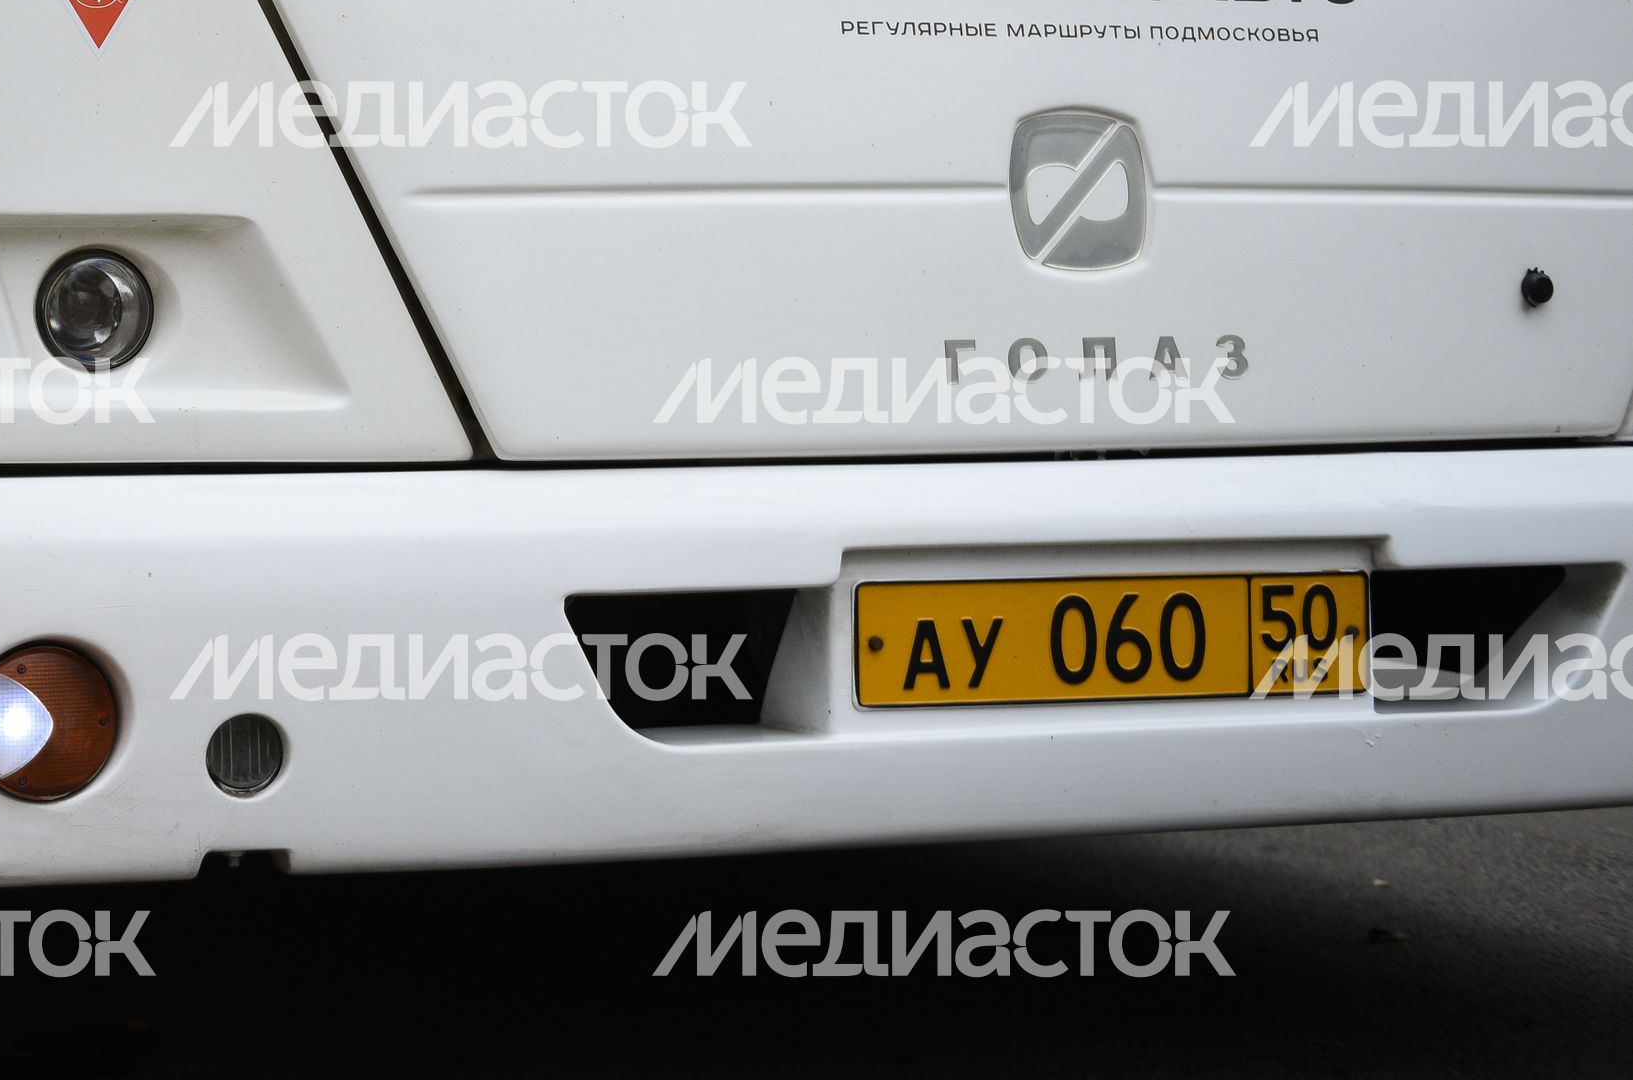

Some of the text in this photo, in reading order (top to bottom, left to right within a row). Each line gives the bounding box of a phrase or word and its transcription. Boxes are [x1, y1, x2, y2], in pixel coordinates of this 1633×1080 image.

[840, 20, 1320, 43] РЕГУЛЯРНЫЕ МАРШРУТЫ ПОДМОСКОВЬЯ
[1050, 592, 1207, 686] 060
[1260, 583, 1339, 652] 50
[1271, 658, 1330, 684] RUS
